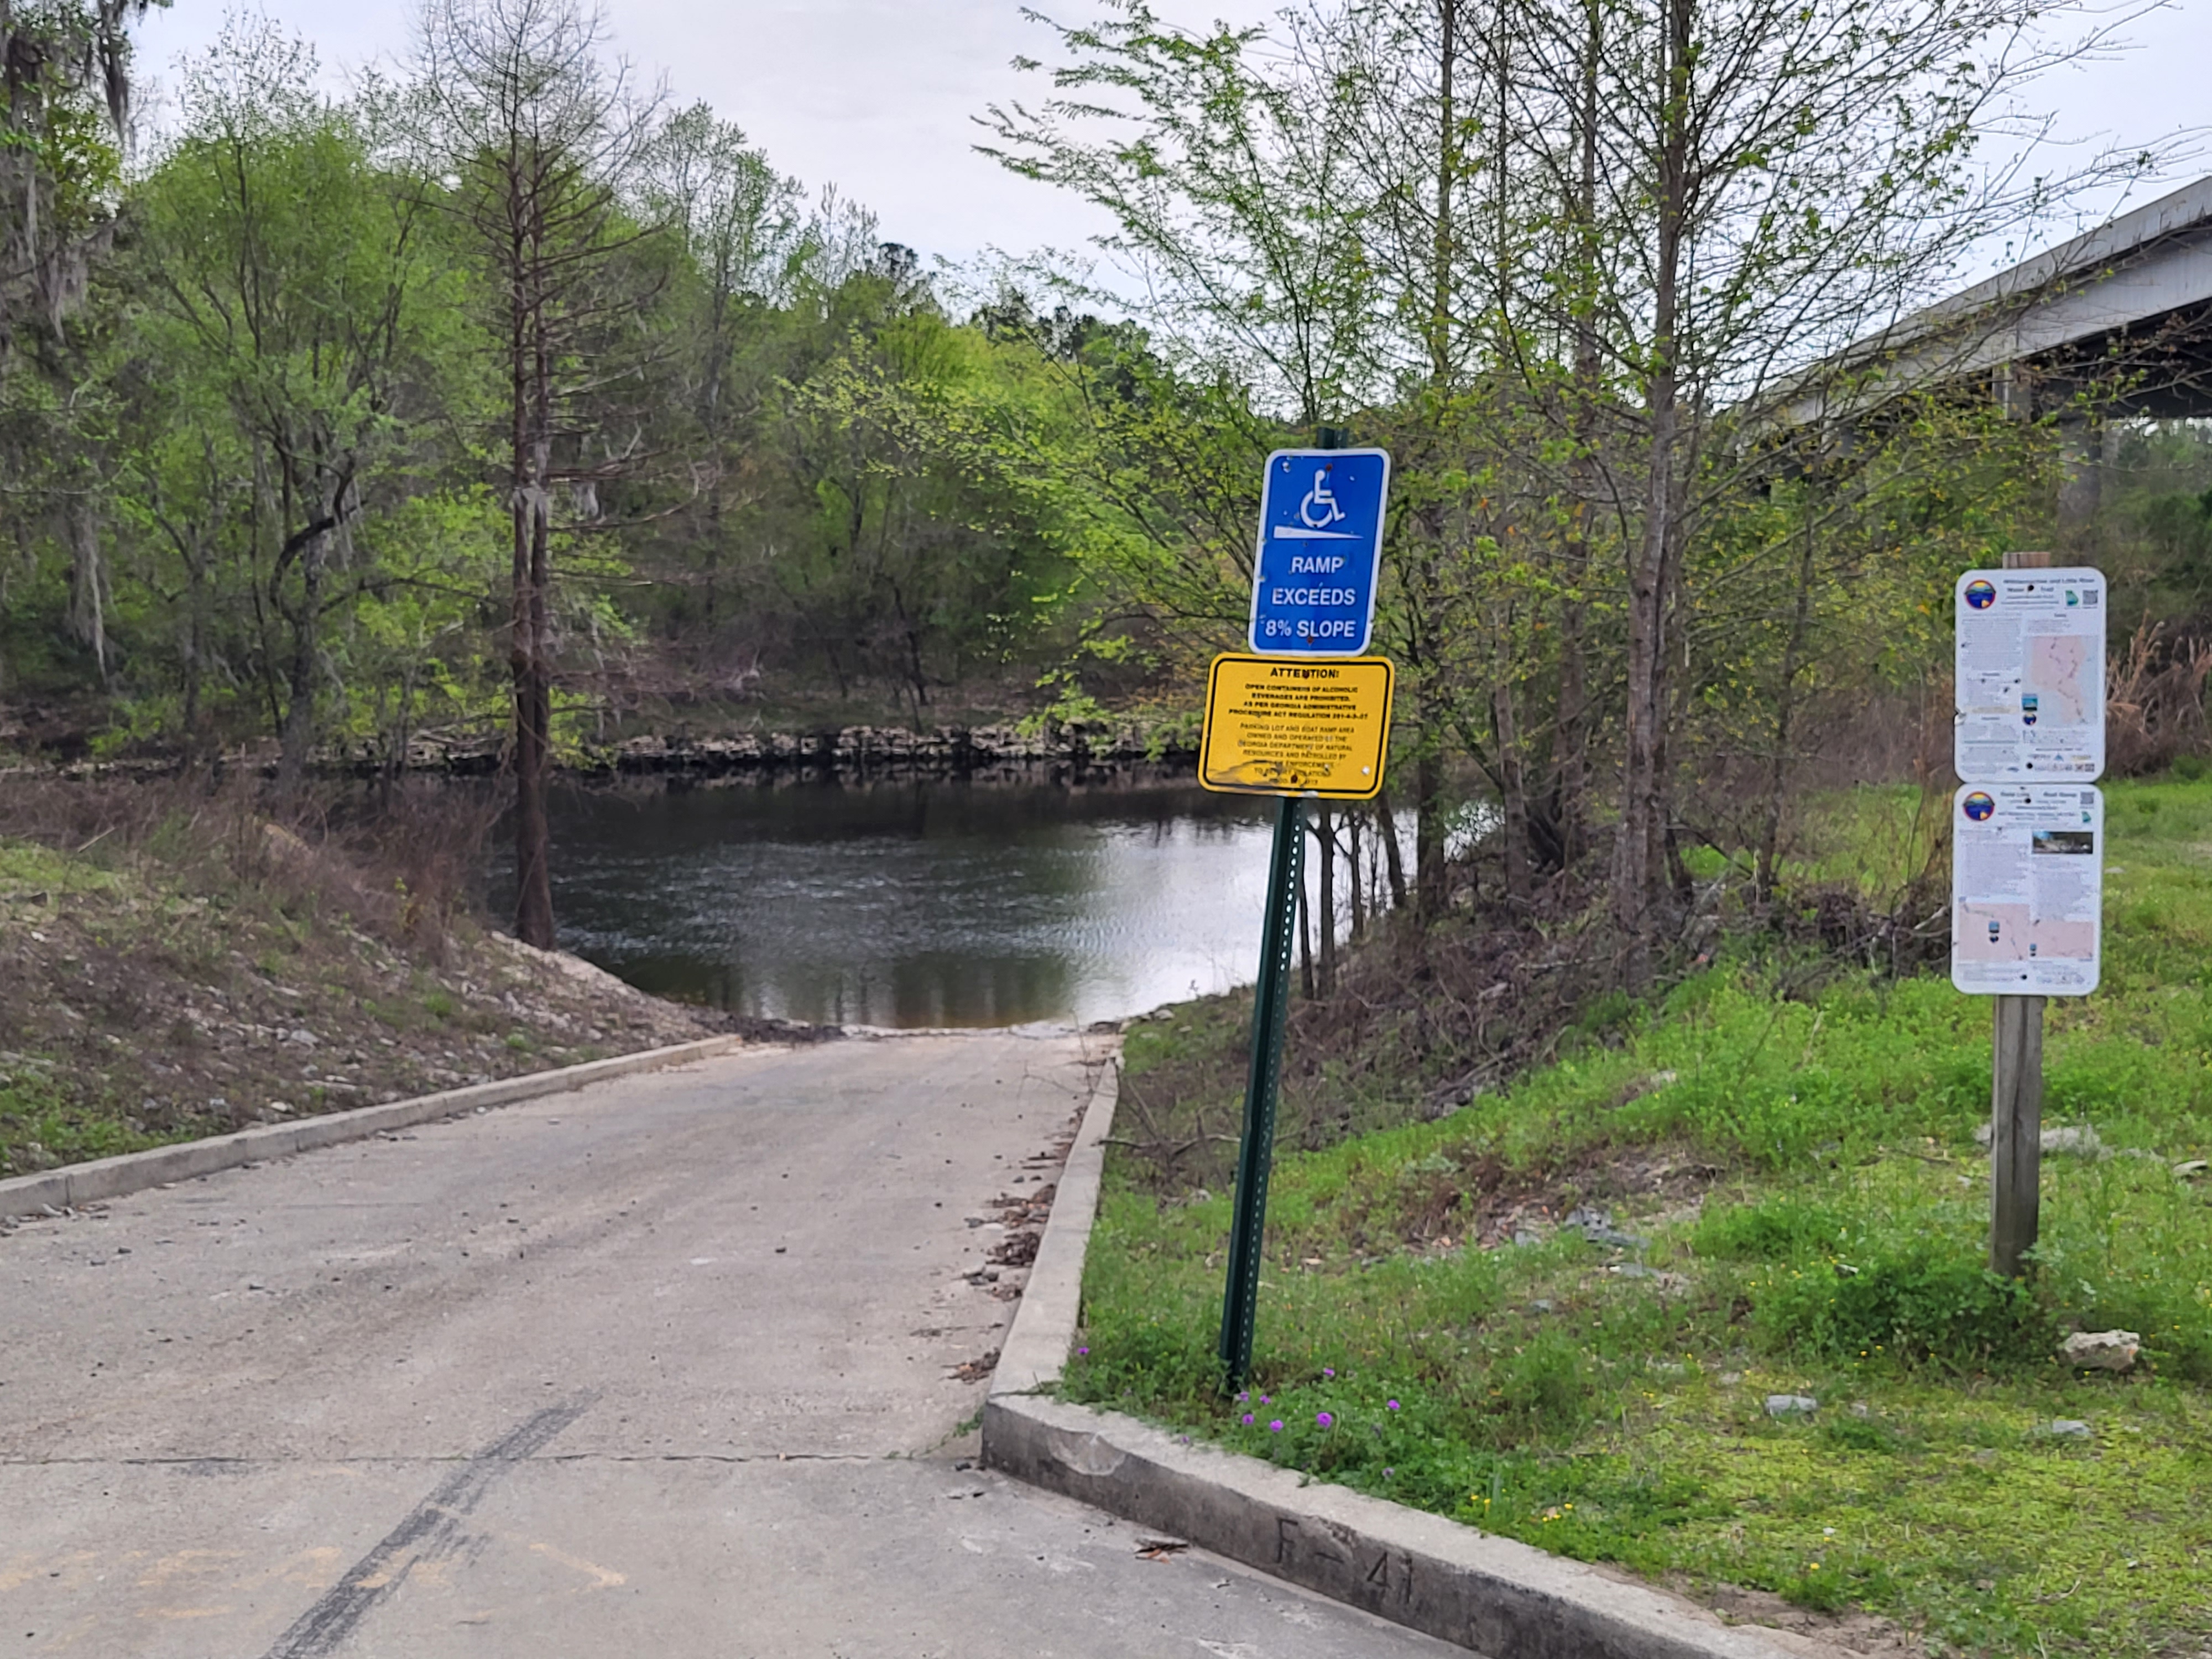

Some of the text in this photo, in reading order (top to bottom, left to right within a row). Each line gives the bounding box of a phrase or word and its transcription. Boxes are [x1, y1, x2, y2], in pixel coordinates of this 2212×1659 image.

[1291, 556, 1344, 573] RAMP
[1272, 588, 1356, 606] EXCEEDS
[1265, 619, 1356, 638] 8% SLOPE
[1240, 722, 1270, 731] PARKING
[1243, 749, 1283, 758] RESOURCES
[1301, 751, 1337, 759] PATROLLED
